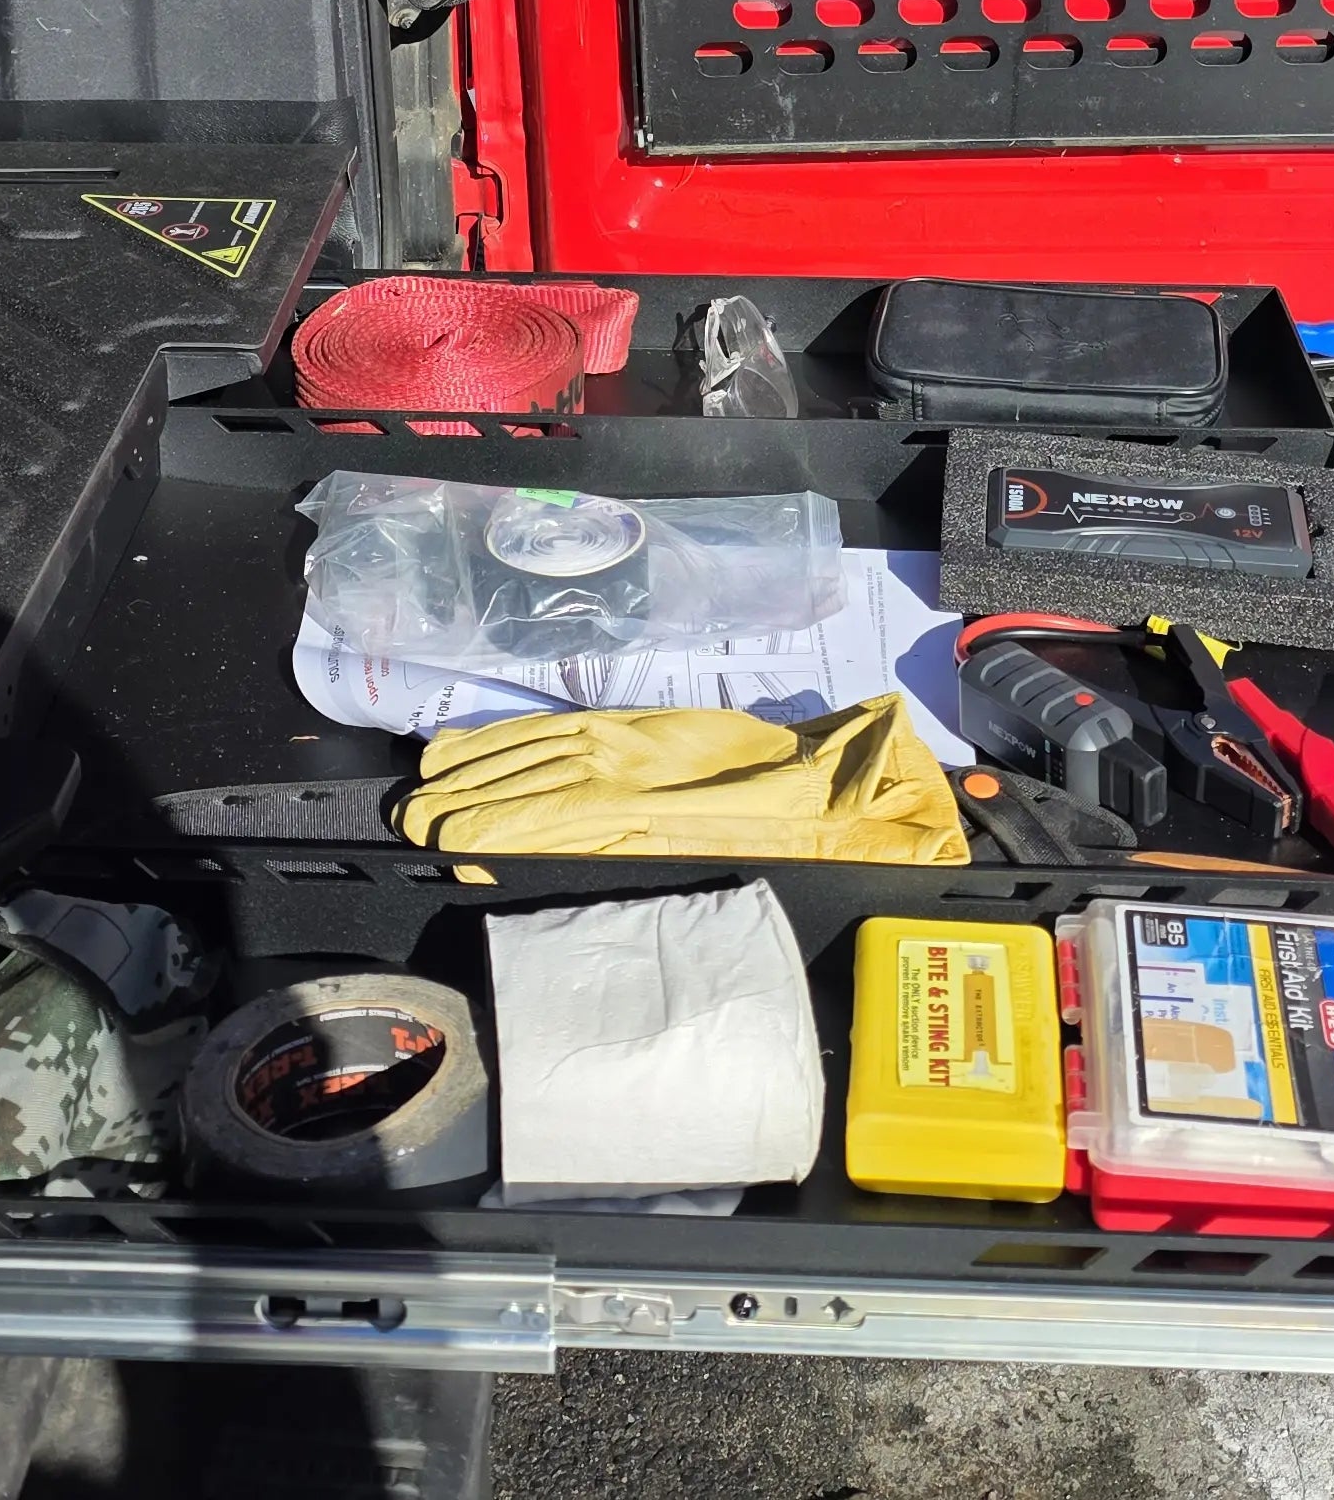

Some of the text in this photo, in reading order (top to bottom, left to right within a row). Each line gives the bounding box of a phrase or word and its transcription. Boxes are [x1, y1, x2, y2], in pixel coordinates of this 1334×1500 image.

[1008, 484, 1025, 512] 1500A
[1232, 528, 1265, 539] 12V
[366, 676, 379, 706] Upon
[437, 701, 451, 717] FOR
[1167, 921, 1185, 946] 85
[901, 956, 910, 980] proven
[1275, 929, 1315, 1032] First Aid Kit
[1167, 982, 1177, 994] An
[902, 991, 910, 1019] remove
[911, 968, 921, 1059] The ONLY suction device
[927, 946, 951, 1087] BITE & STING KIT
[1259, 969, 1285, 1069] FIRST AID ESSENTIALS
[902, 1021, 912, 1043] snake
[975, 1005, 983, 1042] EXTRACTOR
[902, 1045, 910, 1071] venom
